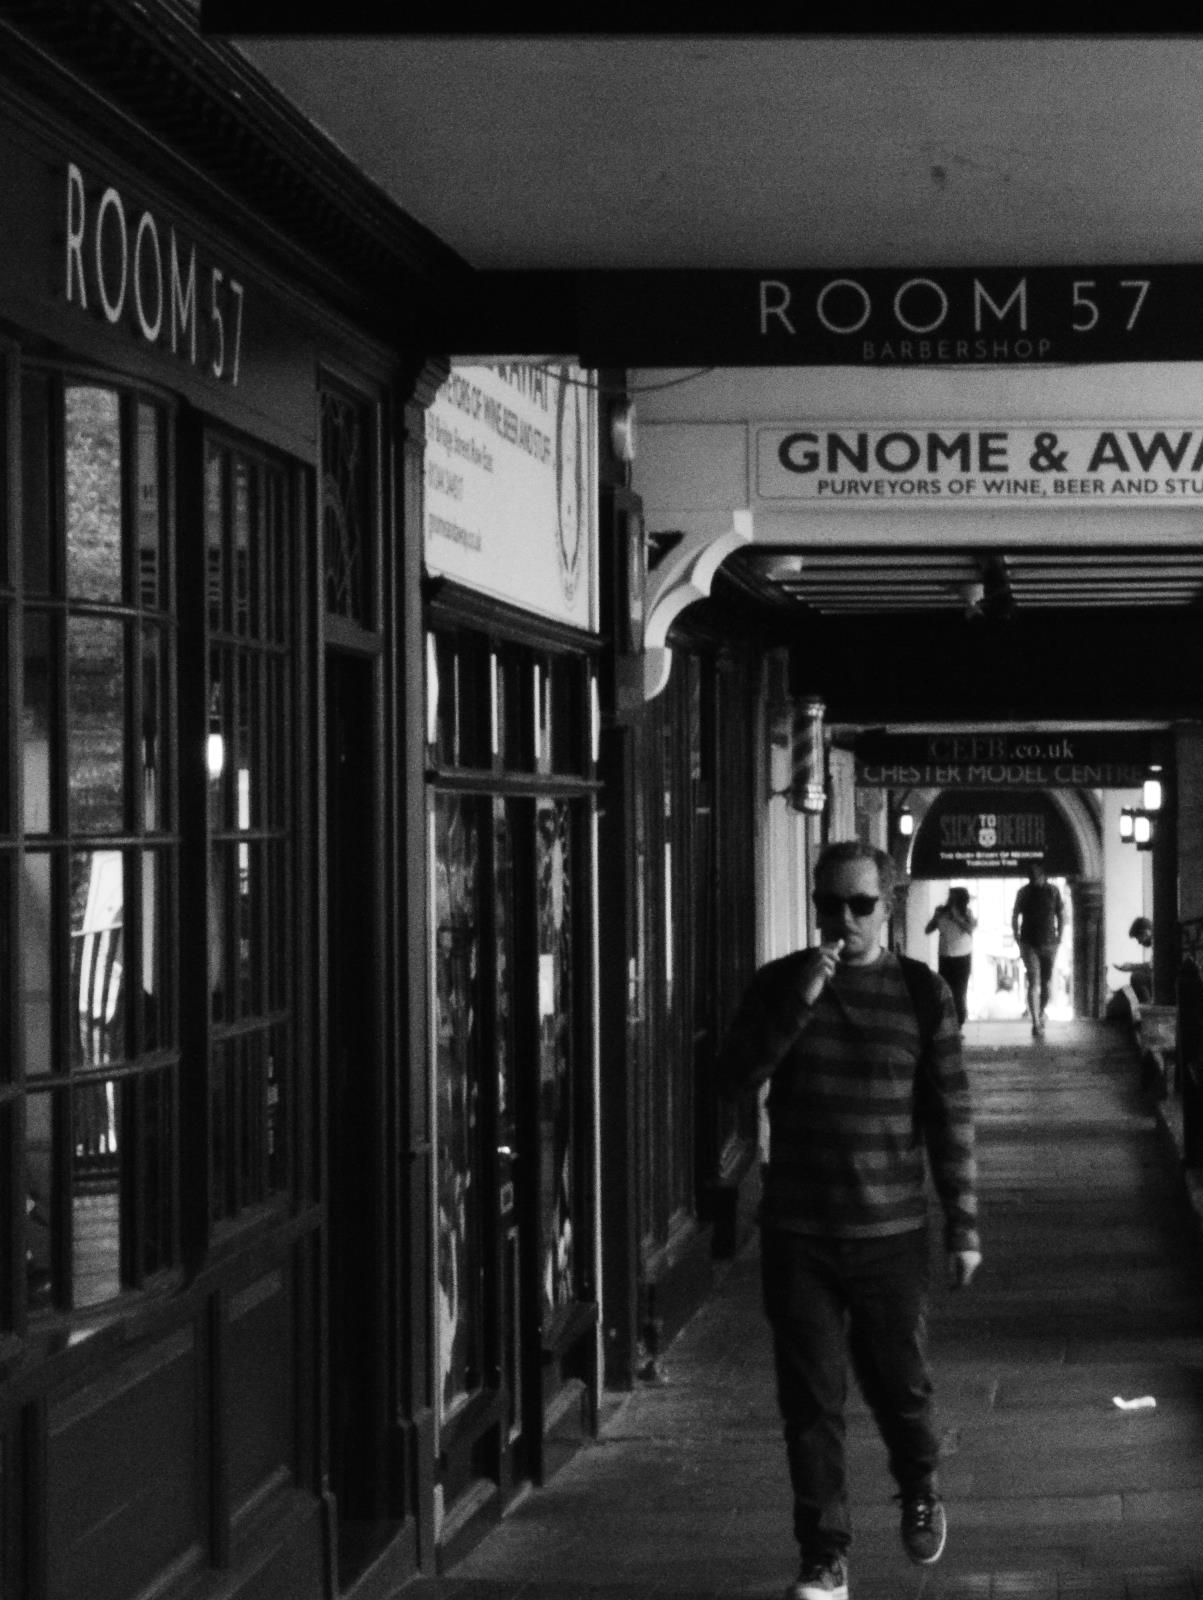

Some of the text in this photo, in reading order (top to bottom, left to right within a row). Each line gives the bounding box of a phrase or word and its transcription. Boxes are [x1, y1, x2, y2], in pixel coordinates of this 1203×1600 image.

[66, 162, 245, 387] ROOM 57
[760, 277, 1152, 335] ROOM 57
[862, 338, 1053, 361] BARBERSHOP
[776, 430, 1009, 474] GNOME
[1028, 431, 1069, 474] &
[816, 478, 942, 497] PURVEYORS
[948, 478, 977, 495] OF
[983, 478, 1048, 498] WINE,
[1053, 478, 1106, 495] BEER
[1111, 478, 1159, 495] AND
[862, 763, 961, 783] CHESTER
[967, 763, 1048, 783] MODEL
[979, 813, 997, 828] TO
